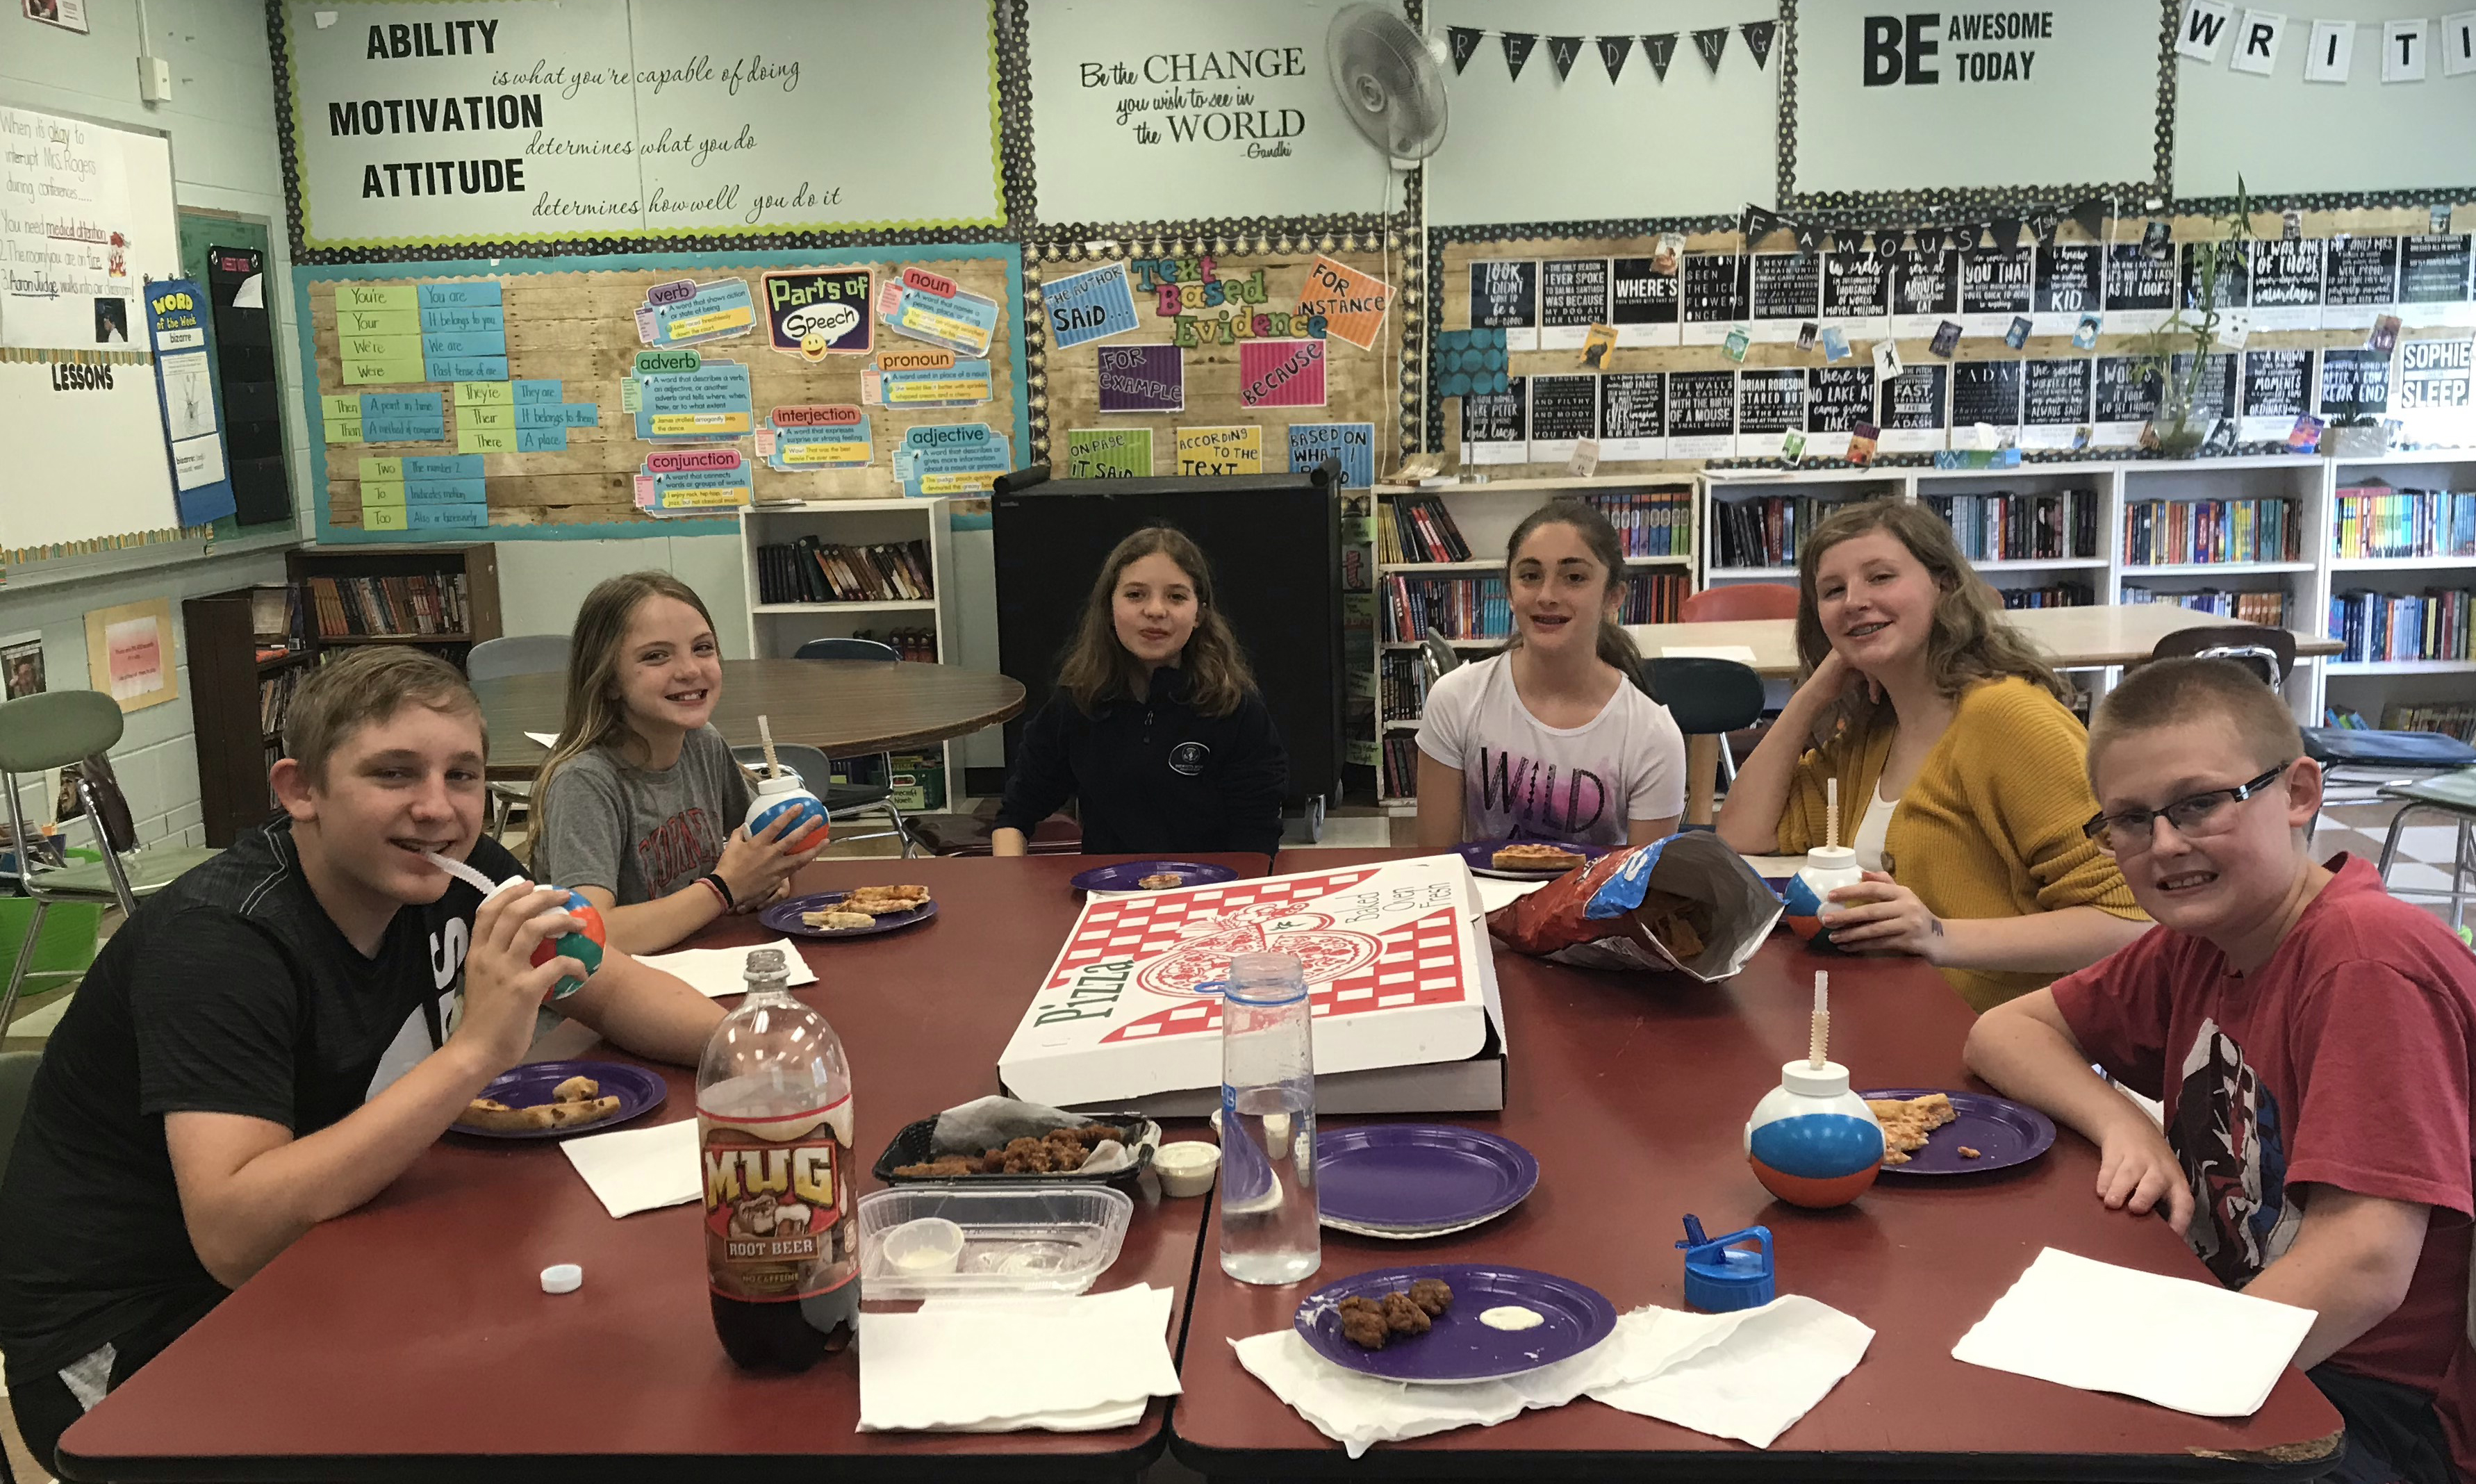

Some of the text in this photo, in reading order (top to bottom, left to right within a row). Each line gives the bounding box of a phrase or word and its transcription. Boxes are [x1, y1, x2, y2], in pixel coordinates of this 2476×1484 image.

[367, 19, 498, 59] ABILITY
[1456, 28, 1767, 67] READING
[1863, 12, 2053, 87] BE AWESOME
[1080, 47, 1305, 88] Be the CHANGE
[1956, 51, 2036, 83] TODAY
[492, 55, 800, 100] is what you're capable of doing
[329, 94, 543, 136] MOTIVATION
[1116, 85, 1254, 126] you wish to see in
[0, 113, 31, 138] When
[48, 121, 69, 151] okay
[75, 124, 84, 145] to
[1132, 108, 1305, 144] the WORLD
[525, 124, 757, 167] determines what you do
[6, 143, 96, 182] interrupt Mrs. Rogers
[6, 171, 35, 204] during
[362, 158, 525, 198] ATTITUDE
[532, 181, 843, 224] determines how well you do it
[1, 209, 106, 242] You need medical attention
[911, 273, 950, 293] noun
[1073, 267, 1123, 296] AUTHOR
[1131, 255, 1217, 292] Text
[1312, 263, 1349, 297] FOR
[1550, 273, 1604, 285] EVER SPOKE
[1966, 263, 2029, 283] YOU THAT
[10, 270, 58, 301] Aaron Judge
[426, 286, 467, 303] You are
[654, 283, 688, 302] verb
[769, 277, 840, 311] Parts
[845, 277, 868, 299] of
[1156, 270, 1268, 317] Based
[1616, 279, 1678, 297] WHERE'S
[152, 292, 193, 315] WORD
[352, 288, 387, 304] You're
[1545, 297, 1564, 306] WAS
[1567, 295, 1604, 306] BECAUSE
[157, 318, 164, 330] of
[167, 318, 179, 329] the
[353, 313, 377, 330] Your
[440, 312, 469, 329] belongs
[472, 312, 480, 324] to
[481, 315, 495, 331] you
[786, 308, 855, 338] Speech
[1173, 306, 1328, 348] Evidence
[170, 333, 192, 343] bizarre
[354, 340, 385, 354] We're
[430, 339, 463, 352] We are
[641, 354, 695, 370] adverb
[884, 354, 949, 369] pronoun
[1101, 347, 1147, 371] FOR
[2404, 343, 2470, 368] SOPHIE
[52, 364, 114, 391] LESSONS
[357, 365, 384, 377] Were
[433, 362, 451, 376] Past
[456, 363, 475, 376] tense
[466, 384, 500, 404] They're
[521, 386, 555, 400] They are
[1740, 378, 1804, 391] BRIAN ROBESON
[1808, 386, 1874, 403] NO LAKE AT
[2402, 380, 2467, 408] SLEEP.
[335, 400, 358, 414] Then
[474, 409, 497, 424] Their
[778, 407, 855, 424] interjection
[534, 409, 563, 427] belongs
[1904, 420, 1932, 428] DASH
[477, 434, 502, 447] There
[525, 432, 561, 452] A place
[913, 428, 983, 447] adjective
[1344, 431, 1367, 445] ON
[1071, 445, 1090, 457] ON
[1214, 446, 1230, 458] TO
[1294, 447, 1341, 461] WHAT
[376, 463, 395, 475] Two
[653, 454, 734, 470] conjunction
[374, 488, 386, 499] To
[374, 511, 391, 525] Too
[1480, 747, 1605, 833] WILD
[1383, 887, 1415, 912] Oven
[1421, 882, 1451, 909] Fresh
[1346, 892, 1379, 925] Baked
[705, 1146, 833, 1210] MUG
[729, 1239, 813, 1256] ROOT BEER
